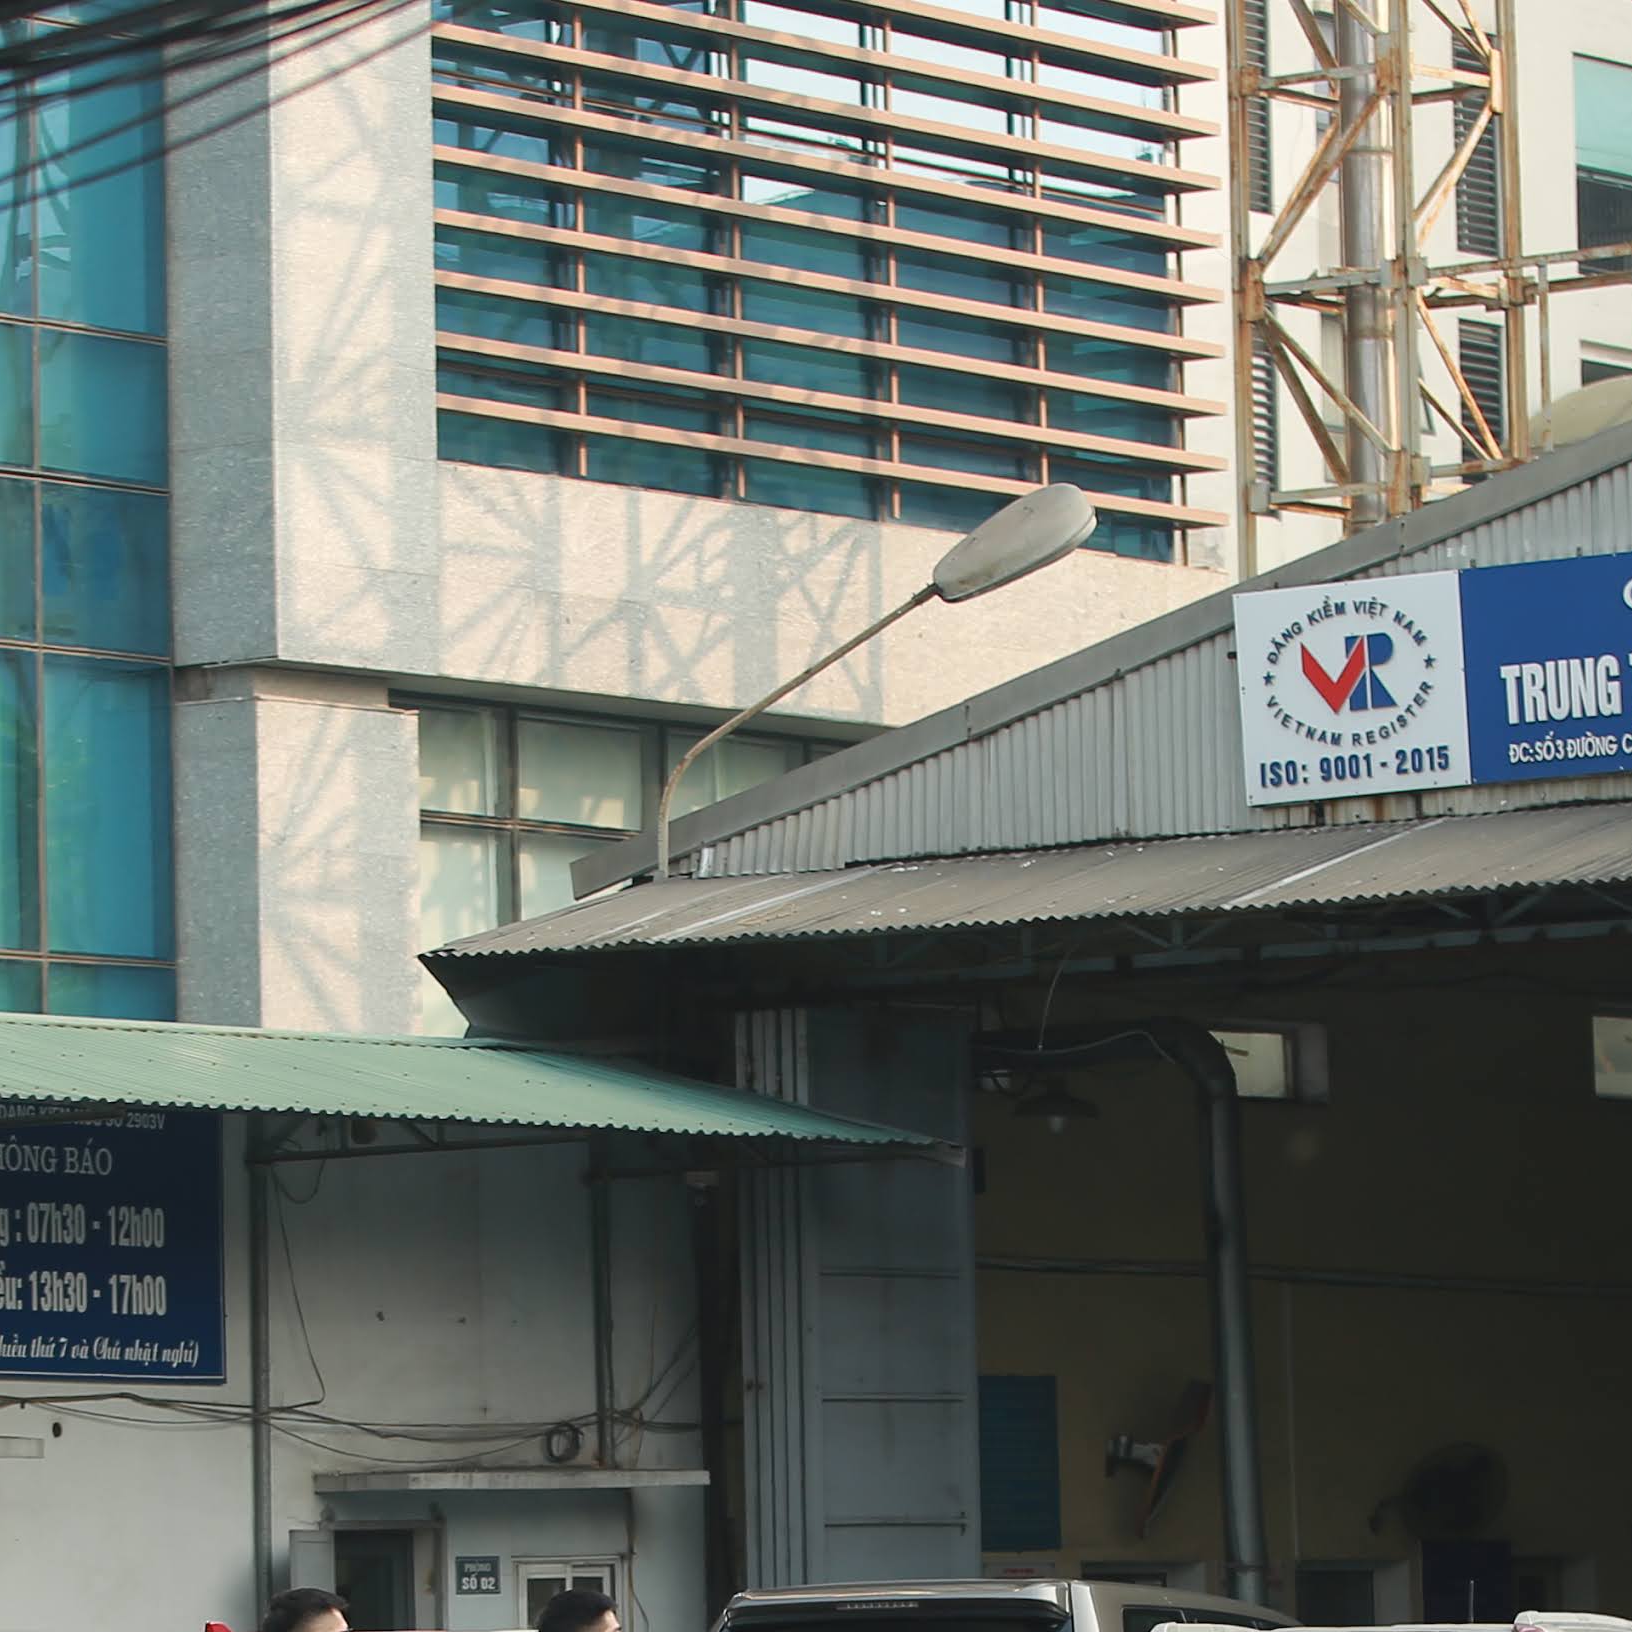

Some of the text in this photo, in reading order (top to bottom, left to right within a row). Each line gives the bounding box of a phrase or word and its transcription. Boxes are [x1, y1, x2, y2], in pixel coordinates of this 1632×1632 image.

[1267, 596, 1427, 665] ĐĂNG KIỂM VIỆT NAM
[1500, 654, 1622, 724] TRUNG
[1266, 681, 1433, 747] VIETNAM REGISTER
[1260, 760, 1309, 788] ISO:
[1319, 753, 1372, 781] 9001
[1395, 745, 1449, 774] 2015
[64, 1138, 112, 1175] BÁO
[26, 1202, 85, 1245] 07h30
[108, 1206, 165, 1248] 12h00
[29, 1270, 87, 1313] 13h30
[109, 1274, 166, 1316] 17h00
[58, 1337, 68, 1358] 7
[124, 1338, 158, 1367] nhật
[462, 1572, 496, 1590] SỐ 02
